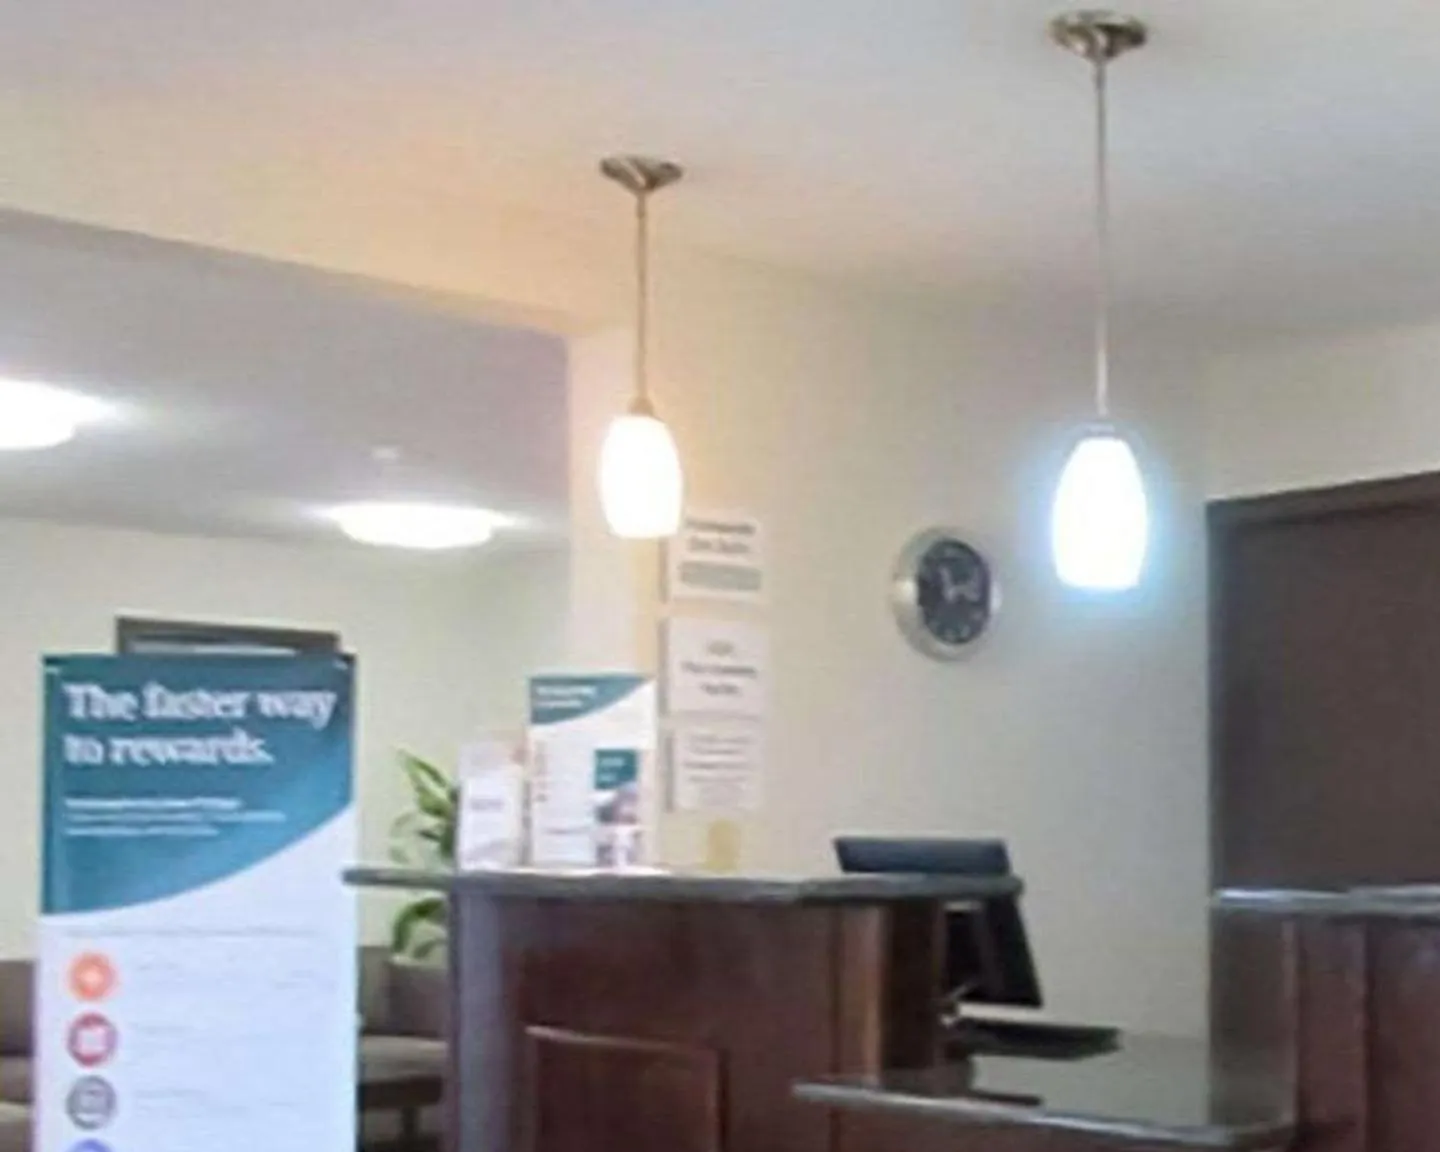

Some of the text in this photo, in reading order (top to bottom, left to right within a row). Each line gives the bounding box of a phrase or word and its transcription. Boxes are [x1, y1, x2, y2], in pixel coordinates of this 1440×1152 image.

[63, 681, 337, 731] The faster way
[63, 733, 104, 765] to
